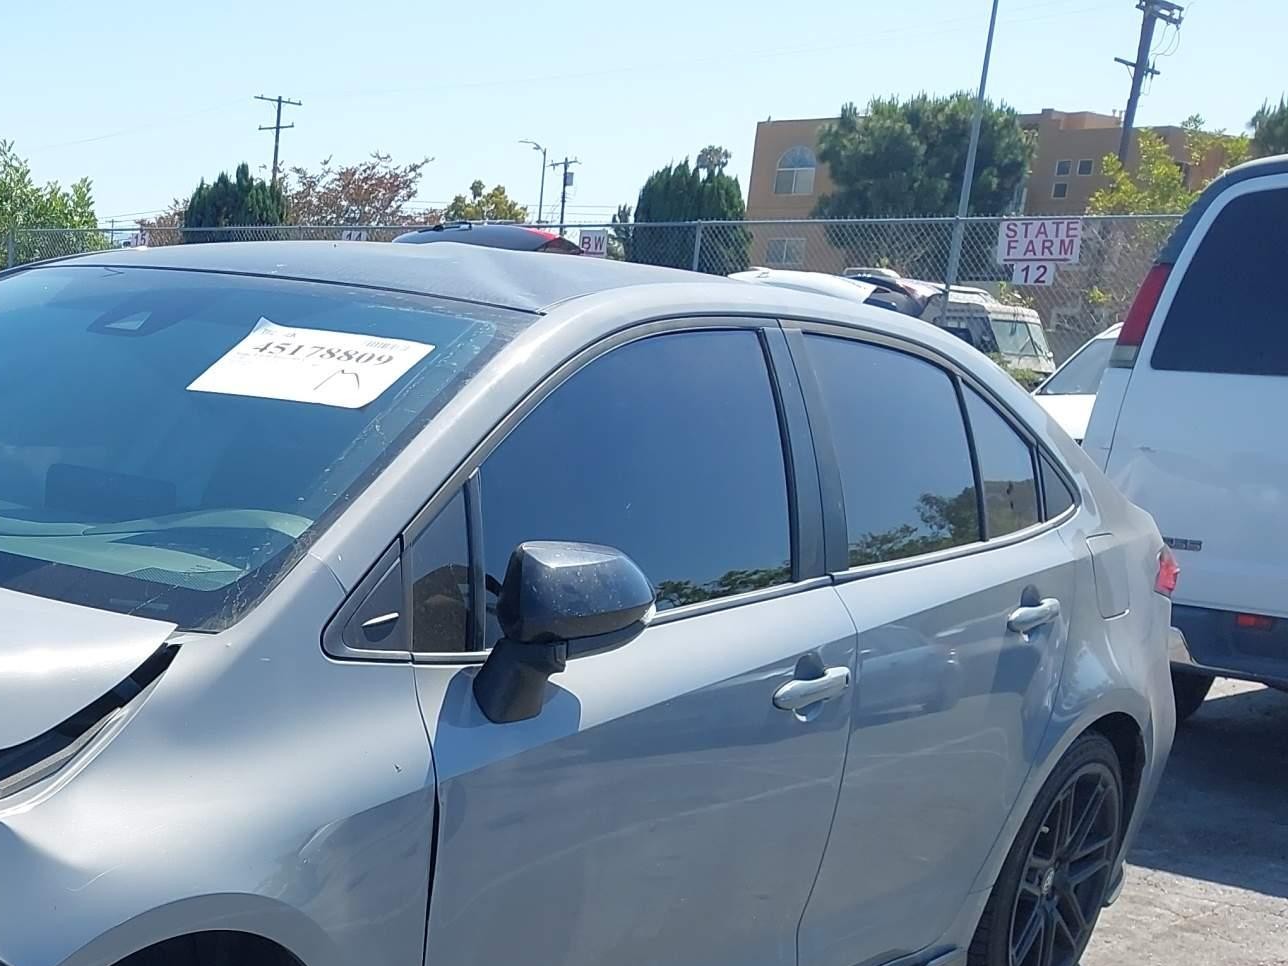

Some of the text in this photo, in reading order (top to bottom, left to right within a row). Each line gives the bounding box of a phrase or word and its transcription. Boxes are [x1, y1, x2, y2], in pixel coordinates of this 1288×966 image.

[1005, 221, 1080, 239] STATE
[582, 236, 605, 250] BW
[1006, 239, 1075, 256] FARM
[1020, 264, 1048, 284] 12
[252, 341, 394, 366] 45178809
